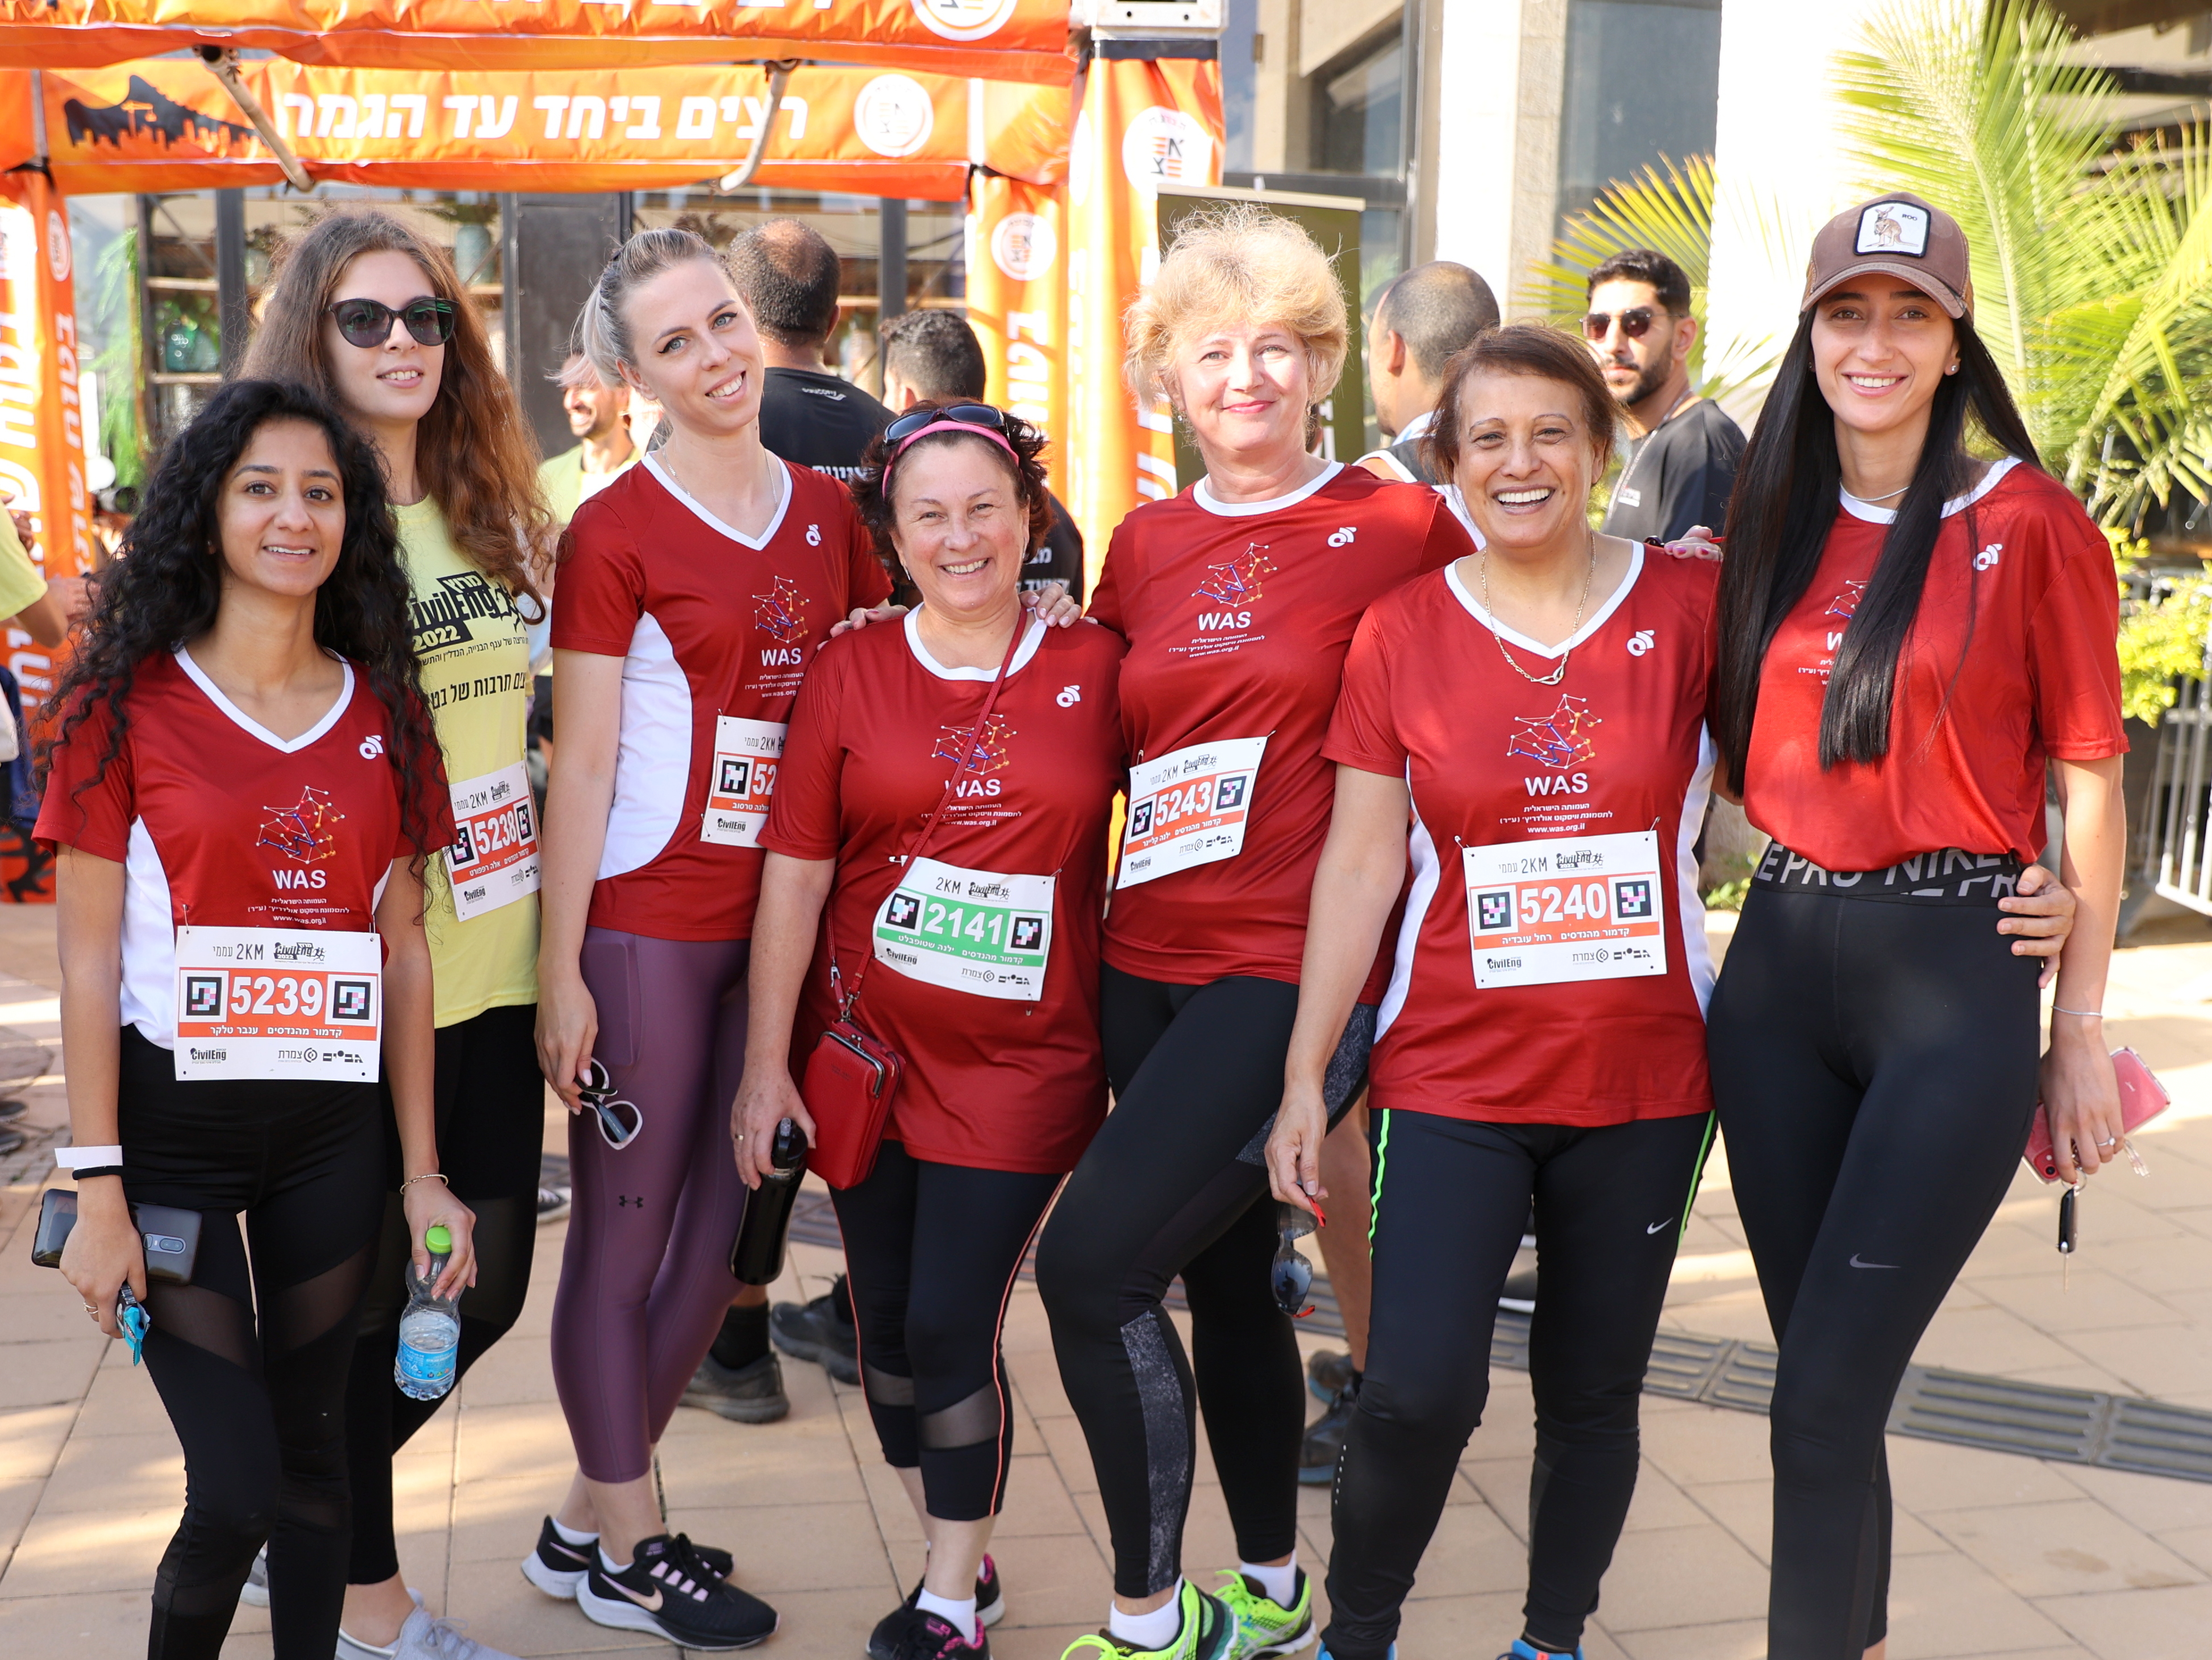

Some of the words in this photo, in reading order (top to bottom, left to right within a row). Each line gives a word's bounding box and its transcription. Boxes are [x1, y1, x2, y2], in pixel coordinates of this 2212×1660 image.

[283, 93, 428, 139] הגמר
[442, 95, 519, 139] עד
[534, 95, 661, 139] ביחד
[676, 95, 808, 139] רצים
[410, 589, 501, 629] ivilEng
[1198, 611, 1251, 631] WAS
[413, 625, 461, 650] 2022
[490, 640, 502, 651] ענף
[1189, 645, 1240, 658] www.was.org.il
[761, 648, 802, 666] WAS
[451, 682, 470, 703] של
[474, 674, 511, 698] תרבות
[760, 737, 775, 751] 2KM
[752, 764, 777, 795] 52
[1162, 765, 1178, 783] 2KM
[945, 779, 1001, 798] WAS
[1525, 772, 1588, 796] WAS
[469, 791, 488, 808] 2KM
[1155, 781, 1212, 826] 5243
[718, 819, 746, 831] CivilEng
[1174, 823, 1200, 836] מהנדסים
[1202, 818, 1221, 828] קדמור
[1527, 823, 1585, 833] www.was.org.il
[475, 811, 517, 854] 5238
[490, 861, 501, 870] אלה
[1499, 863, 1518, 873] עממי
[1521, 857, 1547, 873] 2KM
[273, 869, 326, 890] WAS
[936, 877, 961, 894] 2KM
[1520, 883, 1607, 924] 5240
[273, 915, 326, 925] www.was.org.il
[924, 903, 1003, 945] 2141
[1560, 929, 1600, 940] מהנדסים
[1602, 927, 1630, 937] קדמור
[938, 944, 955, 952] ילנה
[1502, 936, 1532, 945] עובדיה
[213, 946, 233, 957] עממי
[236, 943, 264, 960] 2KM
[275, 942, 313, 957] CivilEng
[886, 948, 918, 965] CivilEng
[962, 949, 997, 961] מהנדסים
[1573, 952, 1595, 962] צמרת
[1000, 955, 1023, 965] קדמור
[1488, 958, 1522, 970] CivilEng
[961, 967, 982, 978] צמרת
[230, 976, 323, 1016] 5239
[210, 1025, 234, 1036] טלקר
[313, 1029, 342, 1038] קדמור
[191, 1049, 226, 1061] CivilEng
[278, 1050, 302, 1059] צמרת
